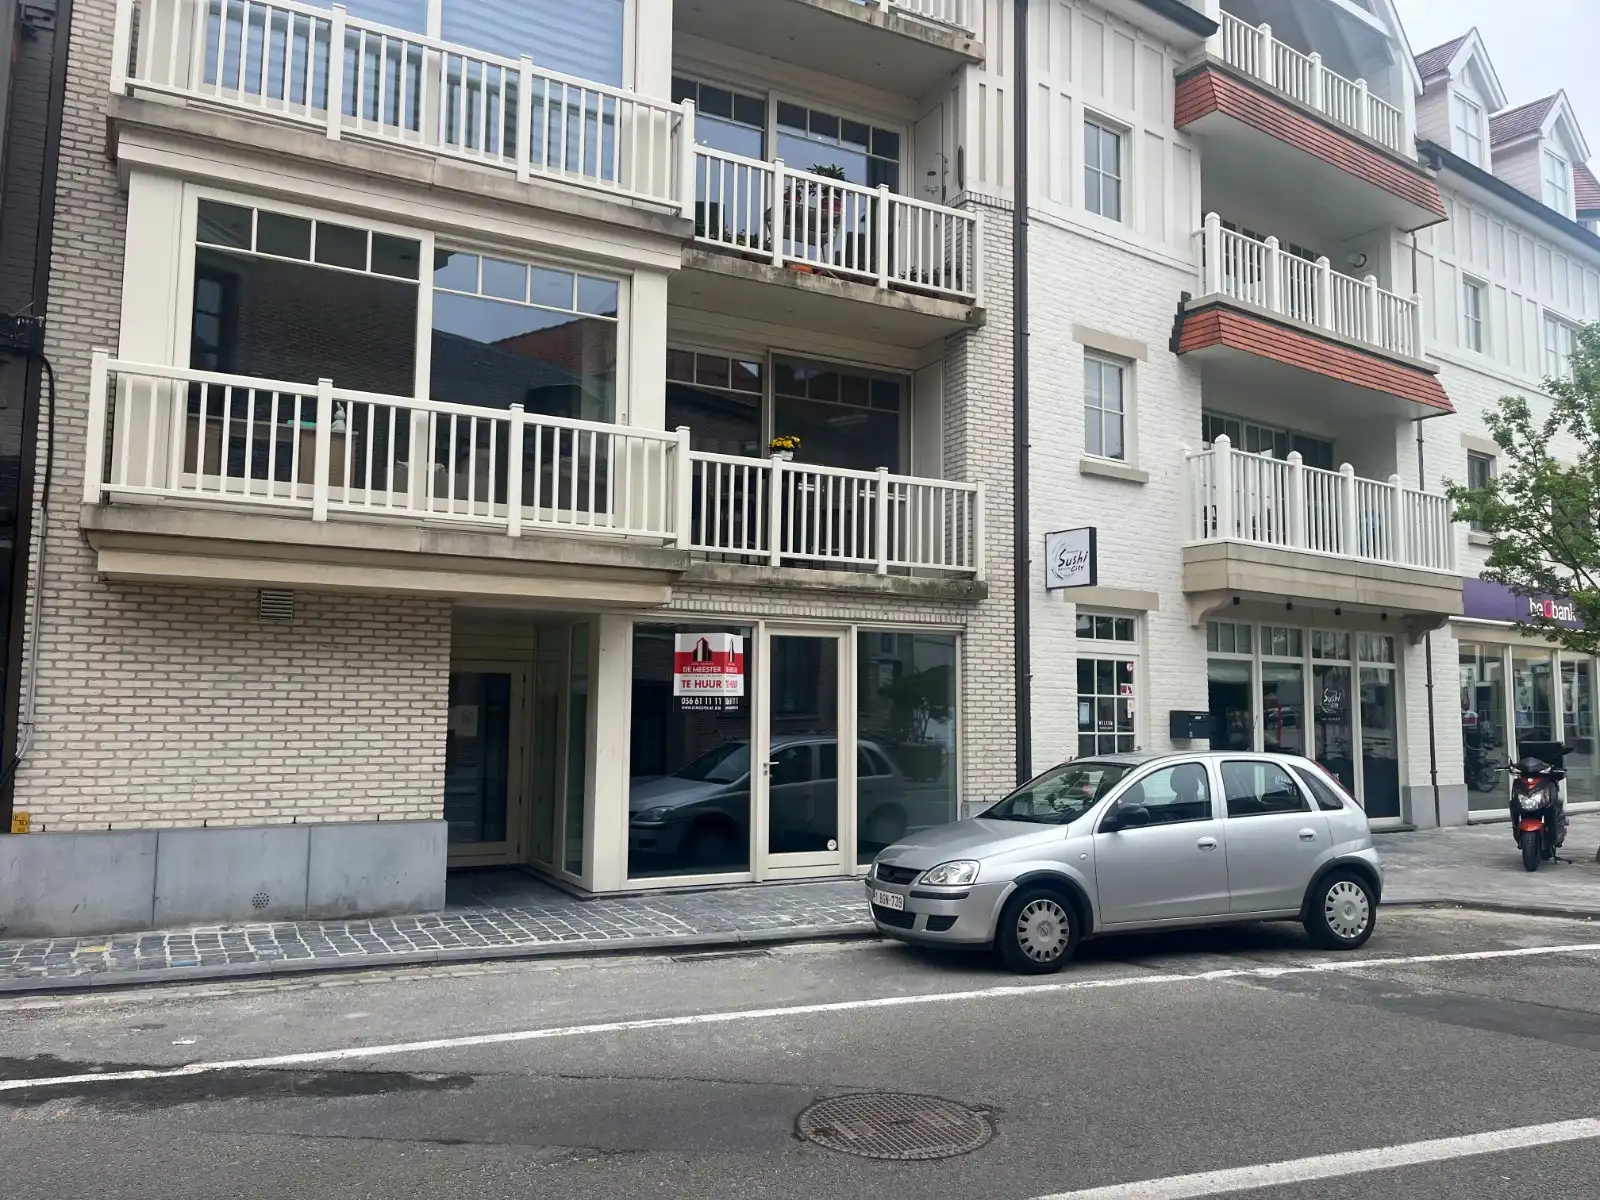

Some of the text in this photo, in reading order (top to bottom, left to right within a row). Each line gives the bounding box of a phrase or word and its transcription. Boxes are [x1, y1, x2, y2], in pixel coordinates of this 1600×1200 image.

[1057, 548, 1089, 568] Sushi
[681, 679, 692, 689] TE
[694, 679, 722, 689] HUUR
[681, 697, 694, 705] 056
[694, 697, 703, 705] 61
[704, 697, 712, 705] 11
[714, 697, 722, 705] 11
